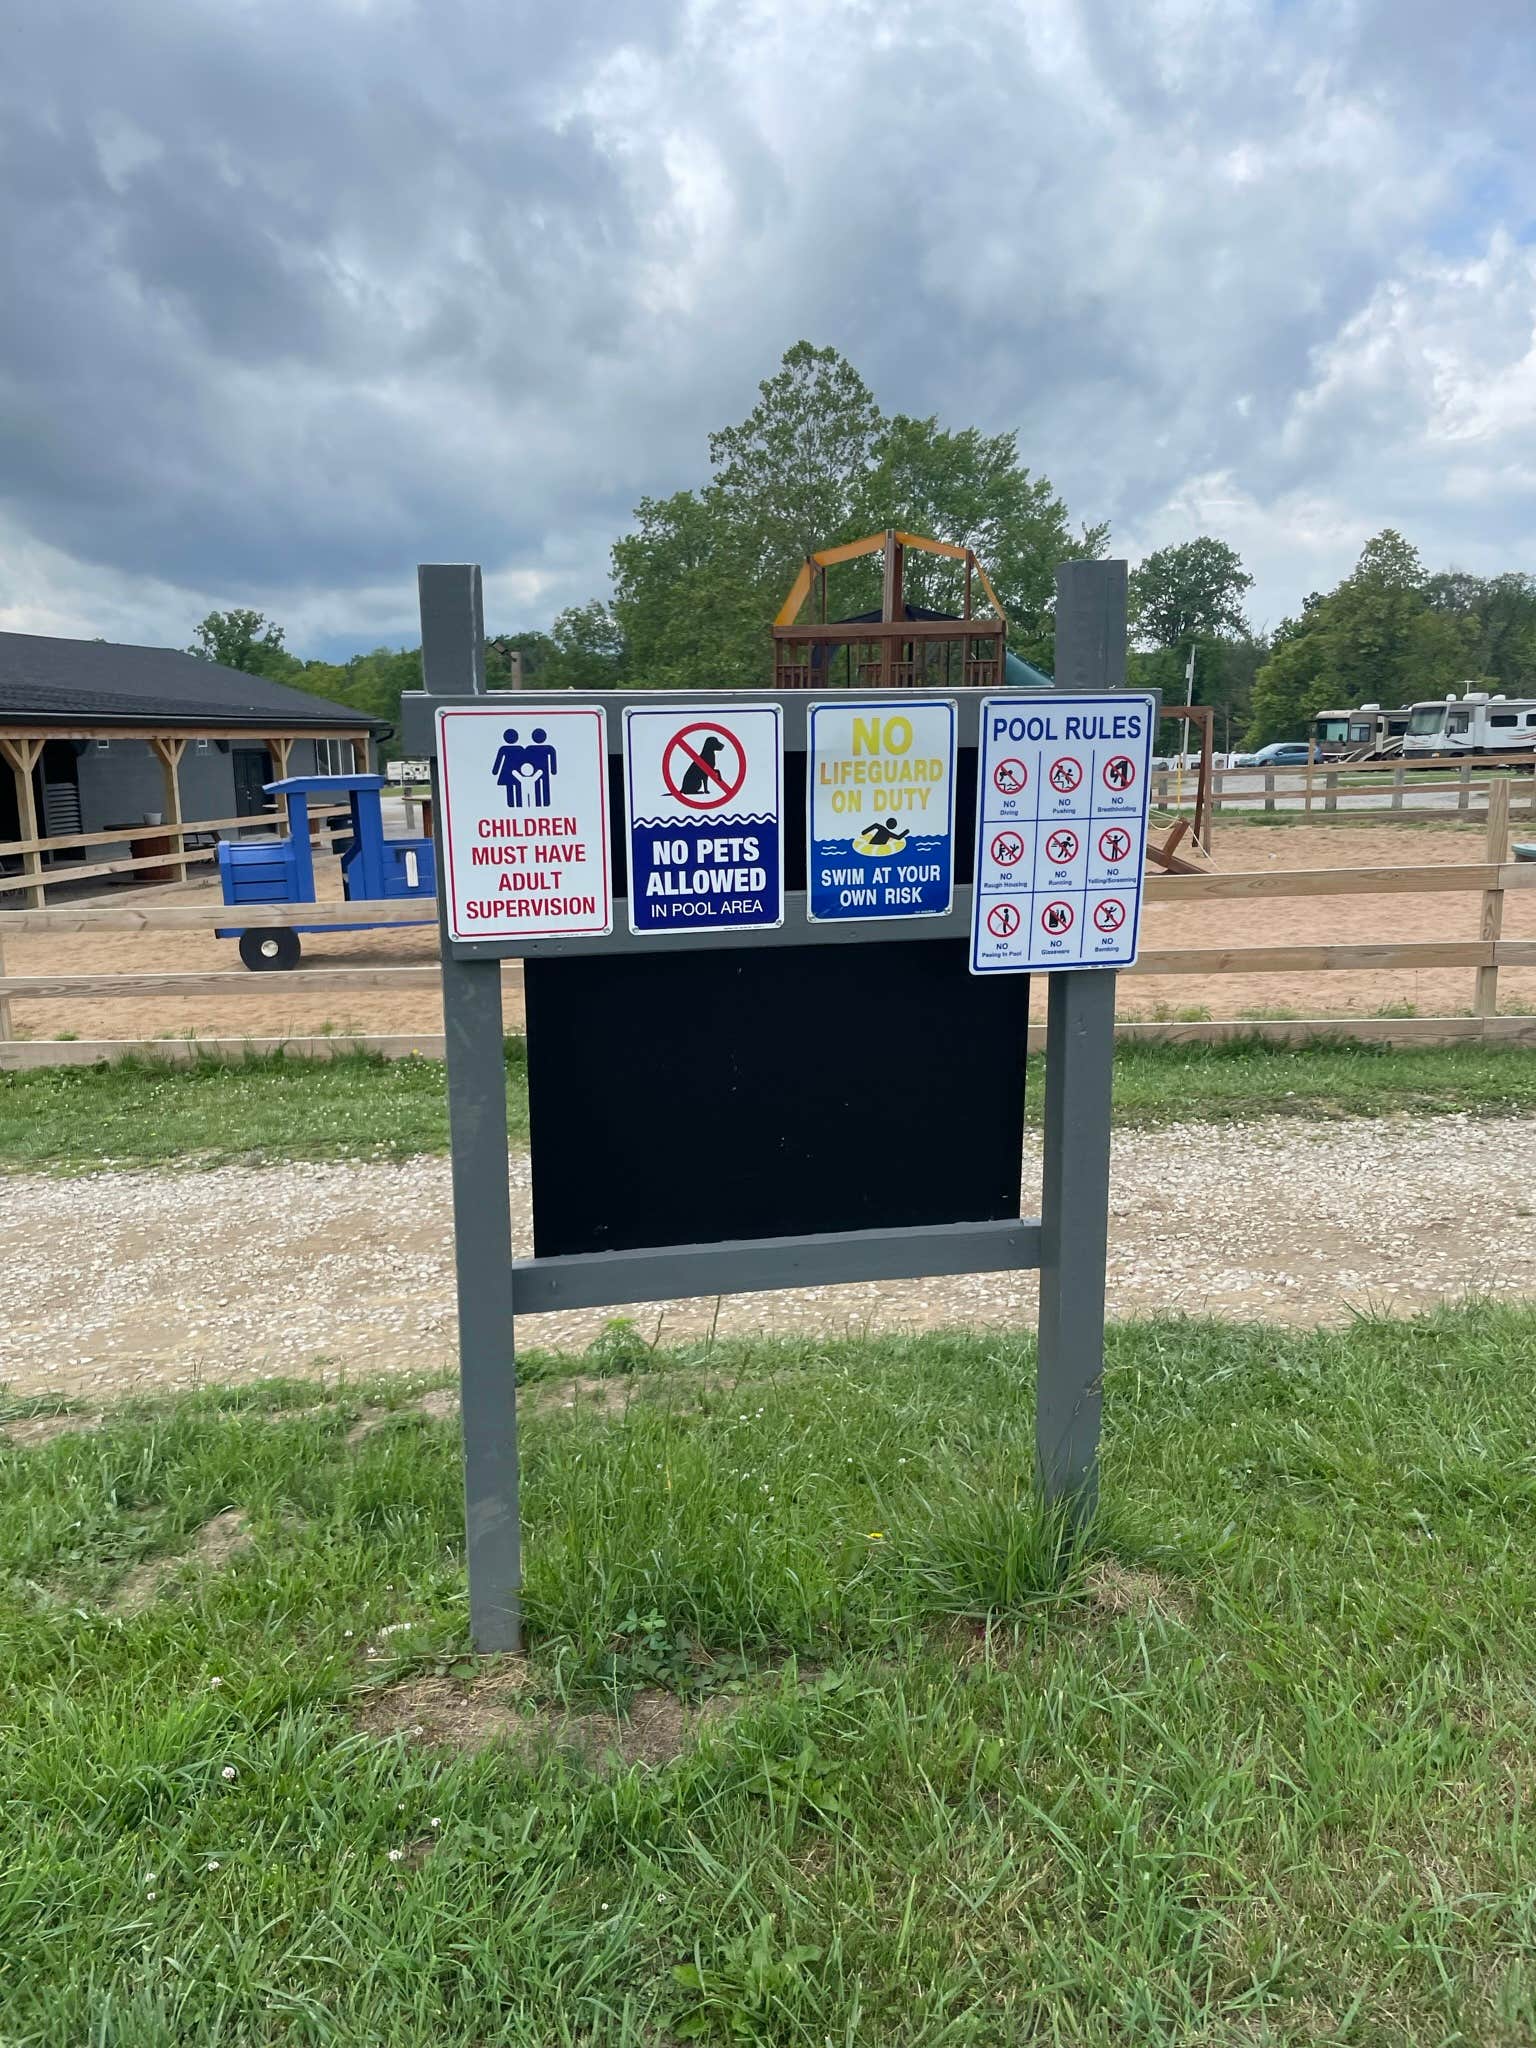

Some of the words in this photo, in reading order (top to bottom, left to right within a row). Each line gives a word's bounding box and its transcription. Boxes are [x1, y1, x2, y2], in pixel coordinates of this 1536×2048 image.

[852, 716, 913, 756] NO
[993, 717, 1058, 741] POOL
[1066, 715, 1141, 739] RULES
[821, 759, 944, 785] LIFEGUARD
[832, 790, 862, 813] ON
[873, 788, 931, 811] DUTY
[1004, 799, 1016, 807] NO
[1053, 807, 1076, 815] Pushing
[1059, 798, 1071, 806] NO
[478, 817, 577, 838] CHILDREN
[472, 845, 528, 865] MUST
[535, 844, 586, 863] HAVE
[653, 840, 689, 865] NO
[697, 837, 760, 863] PETS
[498, 872, 562, 891] ADULT
[646, 867, 766, 896] ALLOWED
[821, 867, 864, 886] SWIM
[872, 866, 892, 884] AT
[896, 864, 941, 882] YOUR
[1107, 868, 1119, 876] NO
[466, 896, 595, 919] SUPERVISION
[840, 889, 877, 907] OWN
[885, 887, 922, 904] RISK
[651, 904, 667, 917] IN
[672, 902, 717, 916] POOL
[721, 900, 763, 913] AREA
